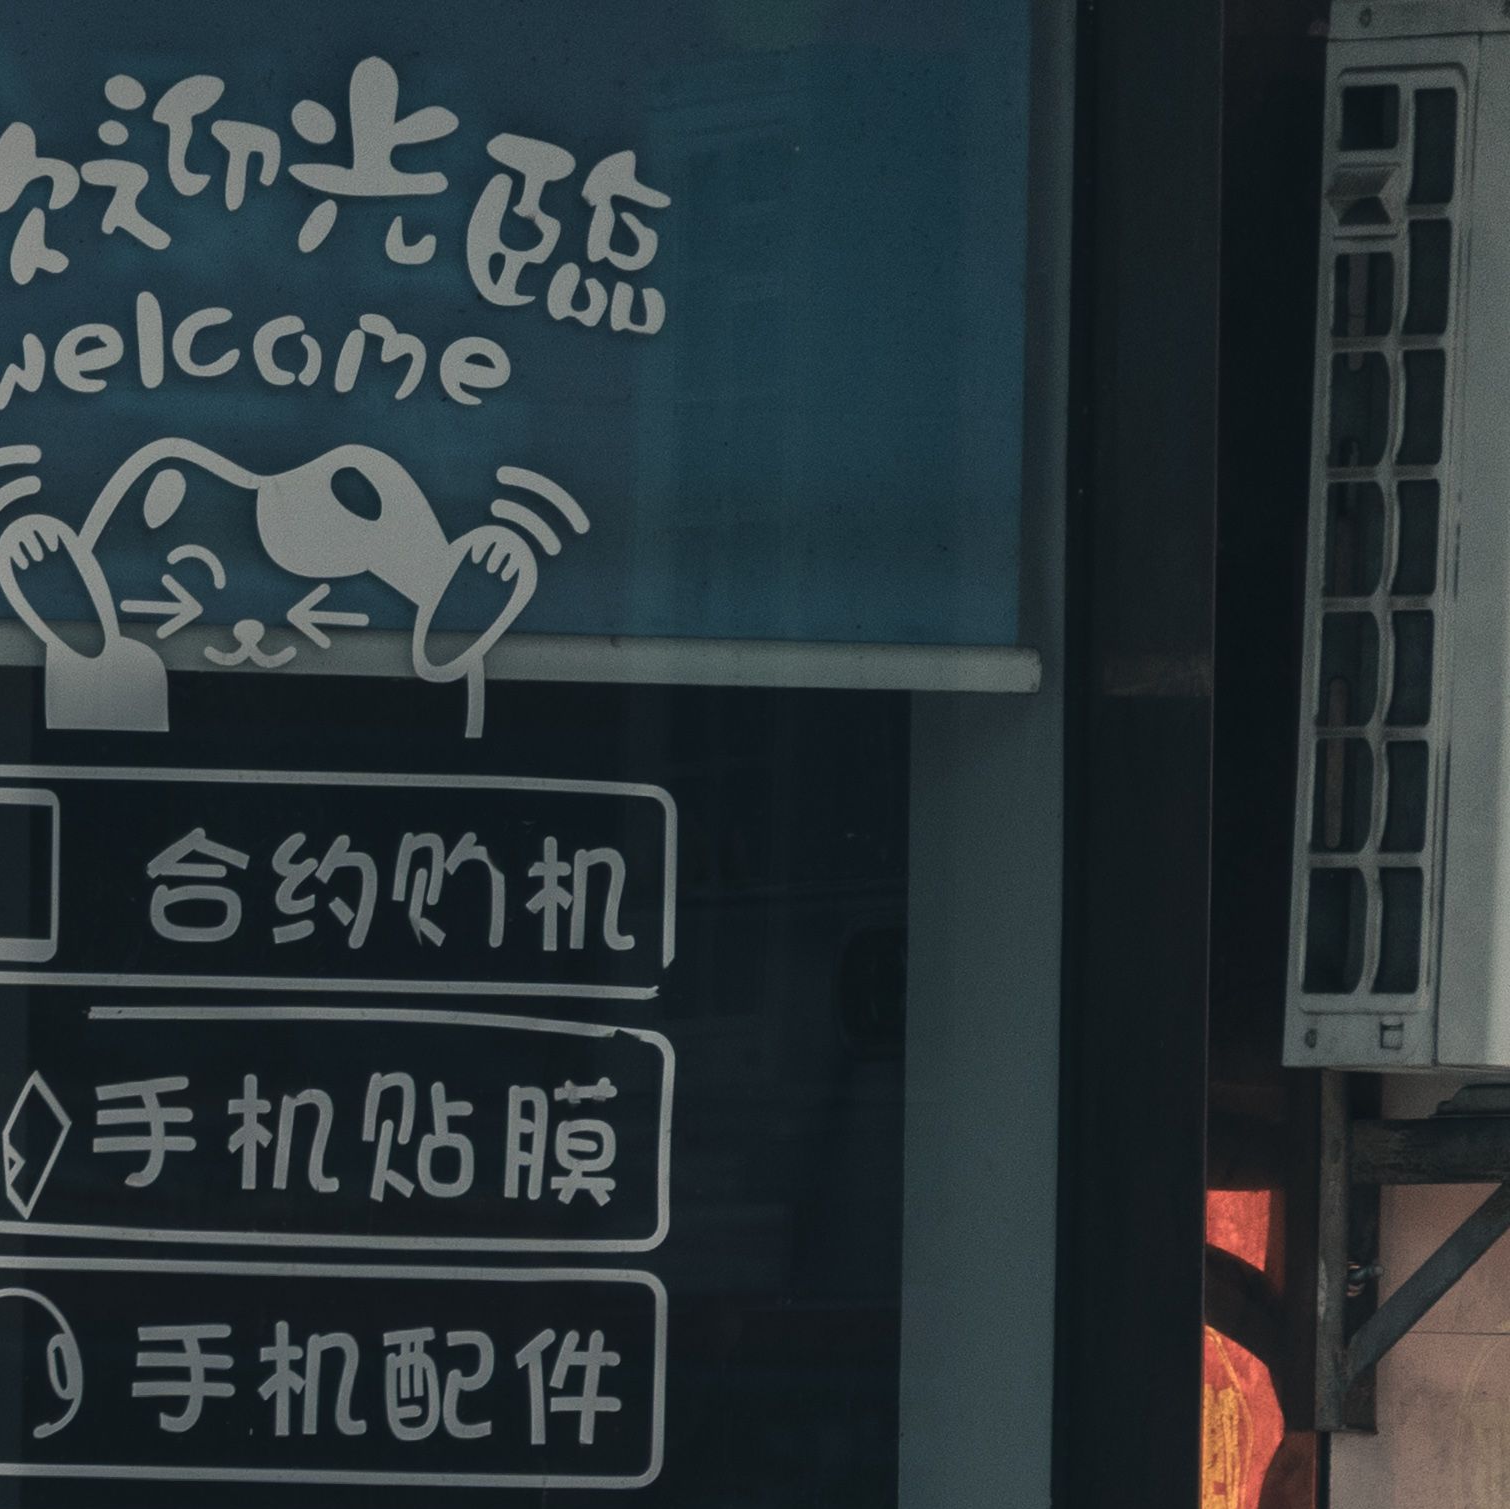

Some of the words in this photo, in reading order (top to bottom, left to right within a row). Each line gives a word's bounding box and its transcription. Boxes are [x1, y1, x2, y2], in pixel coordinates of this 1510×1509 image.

[92, 1071, 618, 1207] 手机贴膜
[132, 1321, 622, 1446] 手机配件
